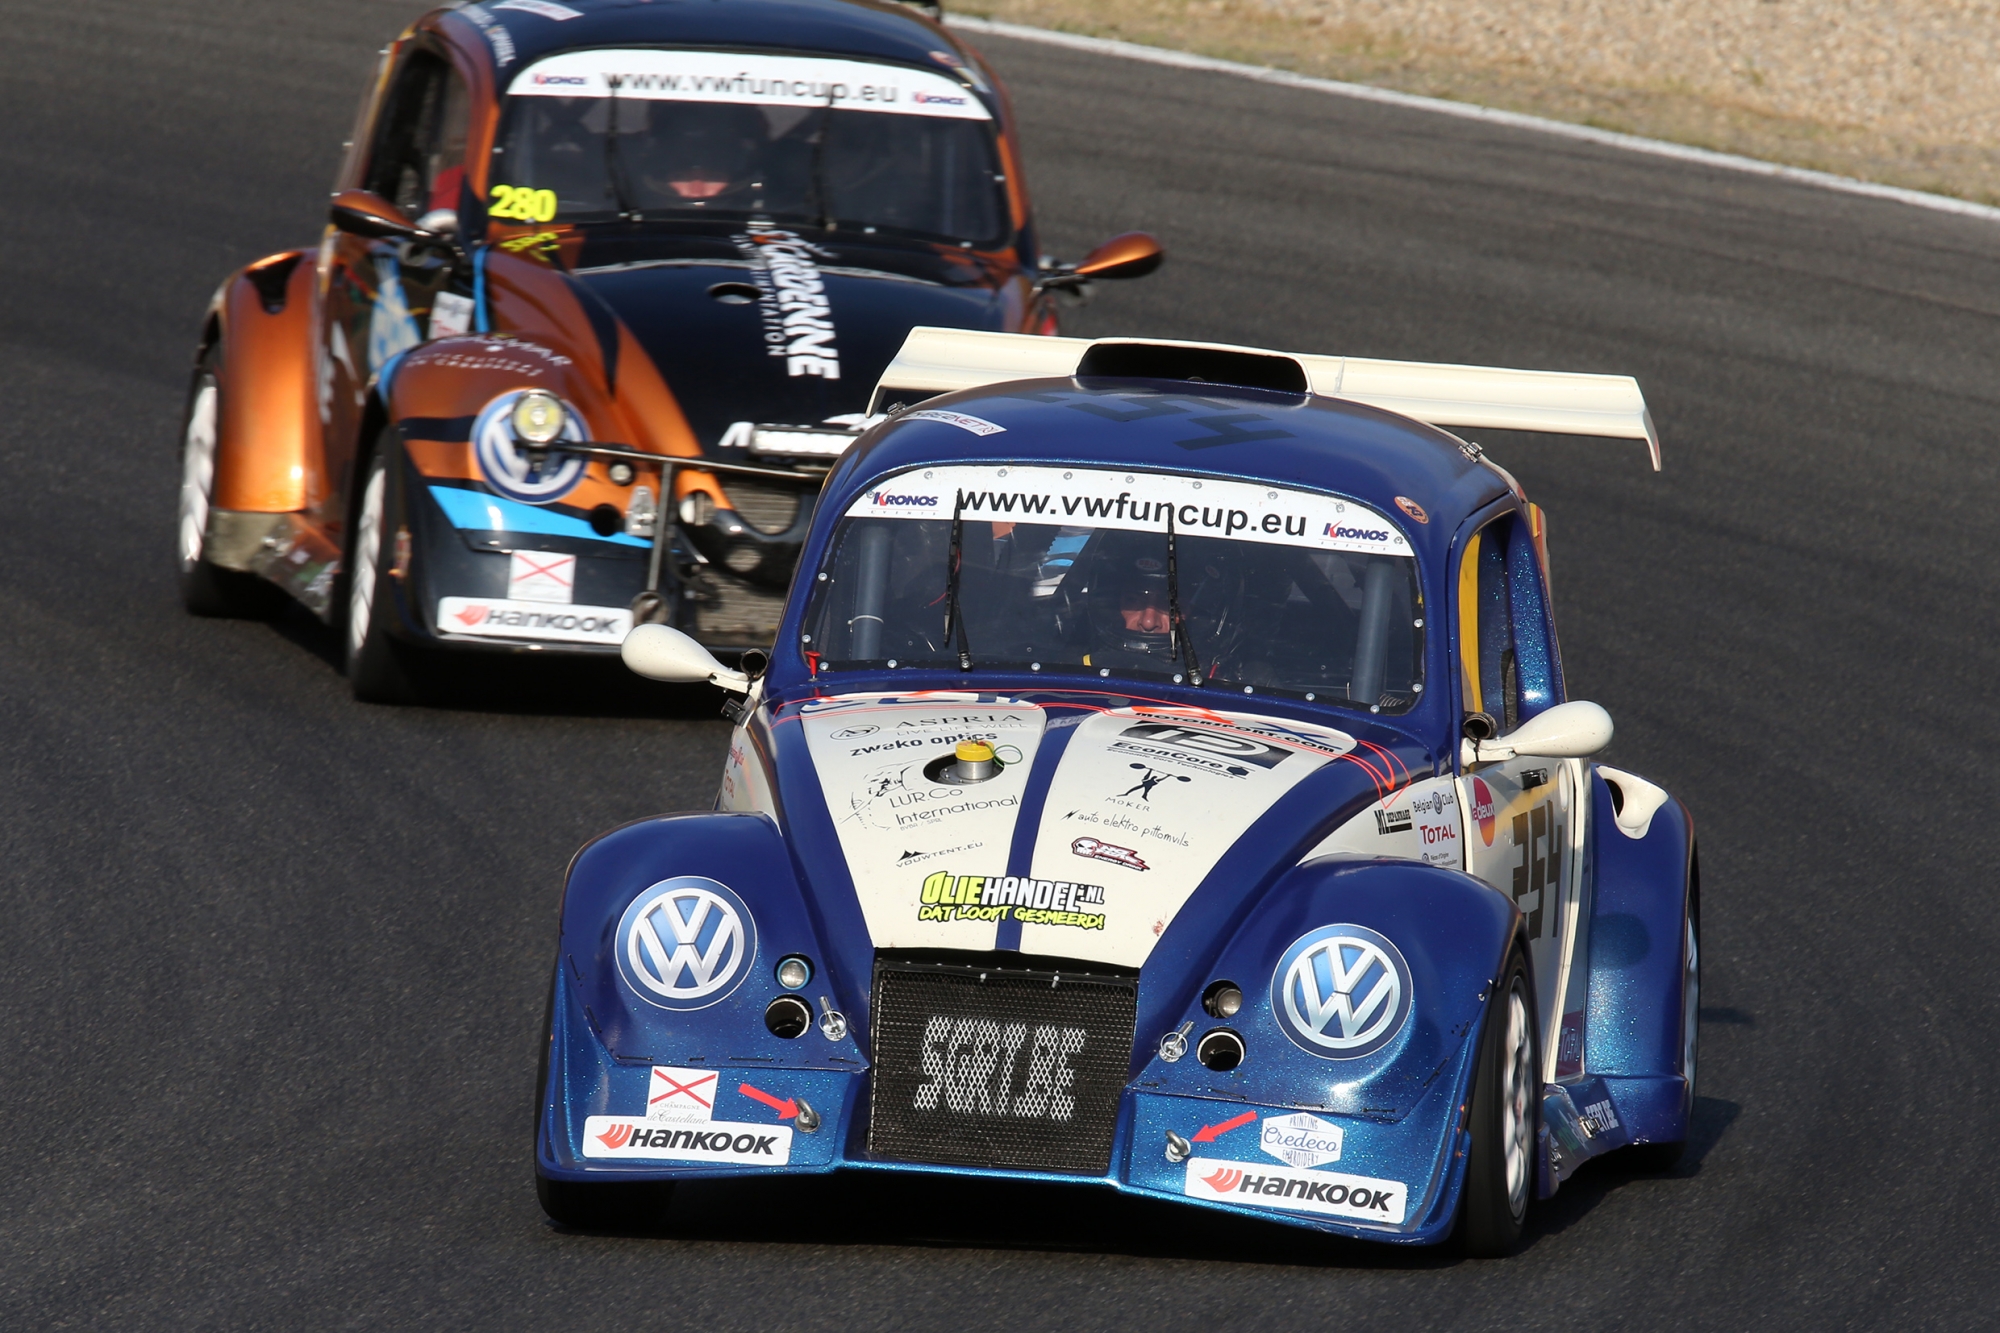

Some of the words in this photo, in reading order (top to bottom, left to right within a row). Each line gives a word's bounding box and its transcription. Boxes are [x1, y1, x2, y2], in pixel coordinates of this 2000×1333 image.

[603, 72, 898, 104] www.vwfuncup.eu
[488, 185, 557, 222] 280
[872, 488, 938, 507] KRONOS
[959, 491, 1307, 537] www.vwfuncup.eu
[1323, 520, 1389, 542] KRONOS
[896, 714, 1024, 729] ASPRIA
[1113, 742, 1223, 769] EconCore
[896, 795, 1018, 826] International
[1105, 797, 1150, 812] MOKER
[1413, 798, 1433, 814] Belgian
[1078, 811, 1099, 823] auto
[1103, 814, 1139, 832] elektro
[1420, 824, 1456, 845] TOTAL
[918, 905, 955, 923] DAT
[955, 905, 1012, 922] LOOPT
[1013, 906, 1105, 931] GESMEERD!
[659, 1102, 700, 1111] CHAMPAGNE
[1289, 1115, 1319, 1130] PRINTING
[1263, 1126, 1339, 1152] Credeco
[1282, 1149, 1320, 1167] EMBROIDERY
